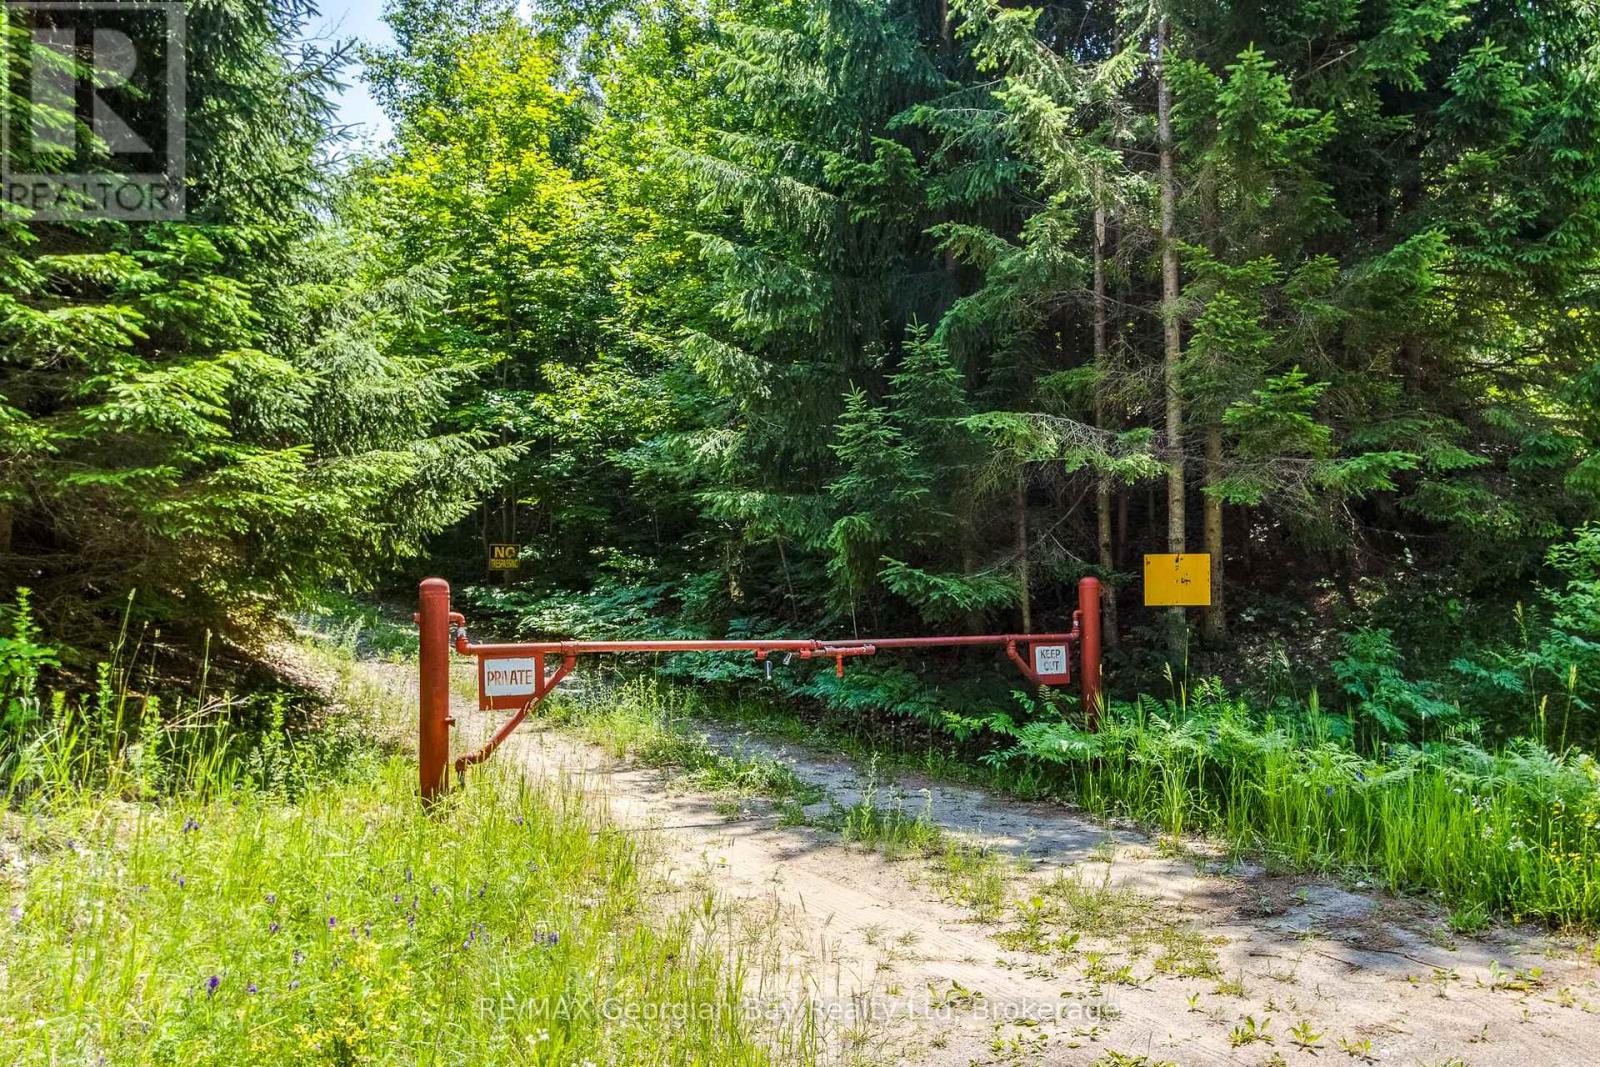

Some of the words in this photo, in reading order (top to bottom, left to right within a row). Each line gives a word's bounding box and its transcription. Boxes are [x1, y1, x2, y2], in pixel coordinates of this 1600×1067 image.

[494, 546, 516, 559] NO
[1040, 649, 1061, 659] KEEP
[487, 669, 533, 686] PRIVATE
